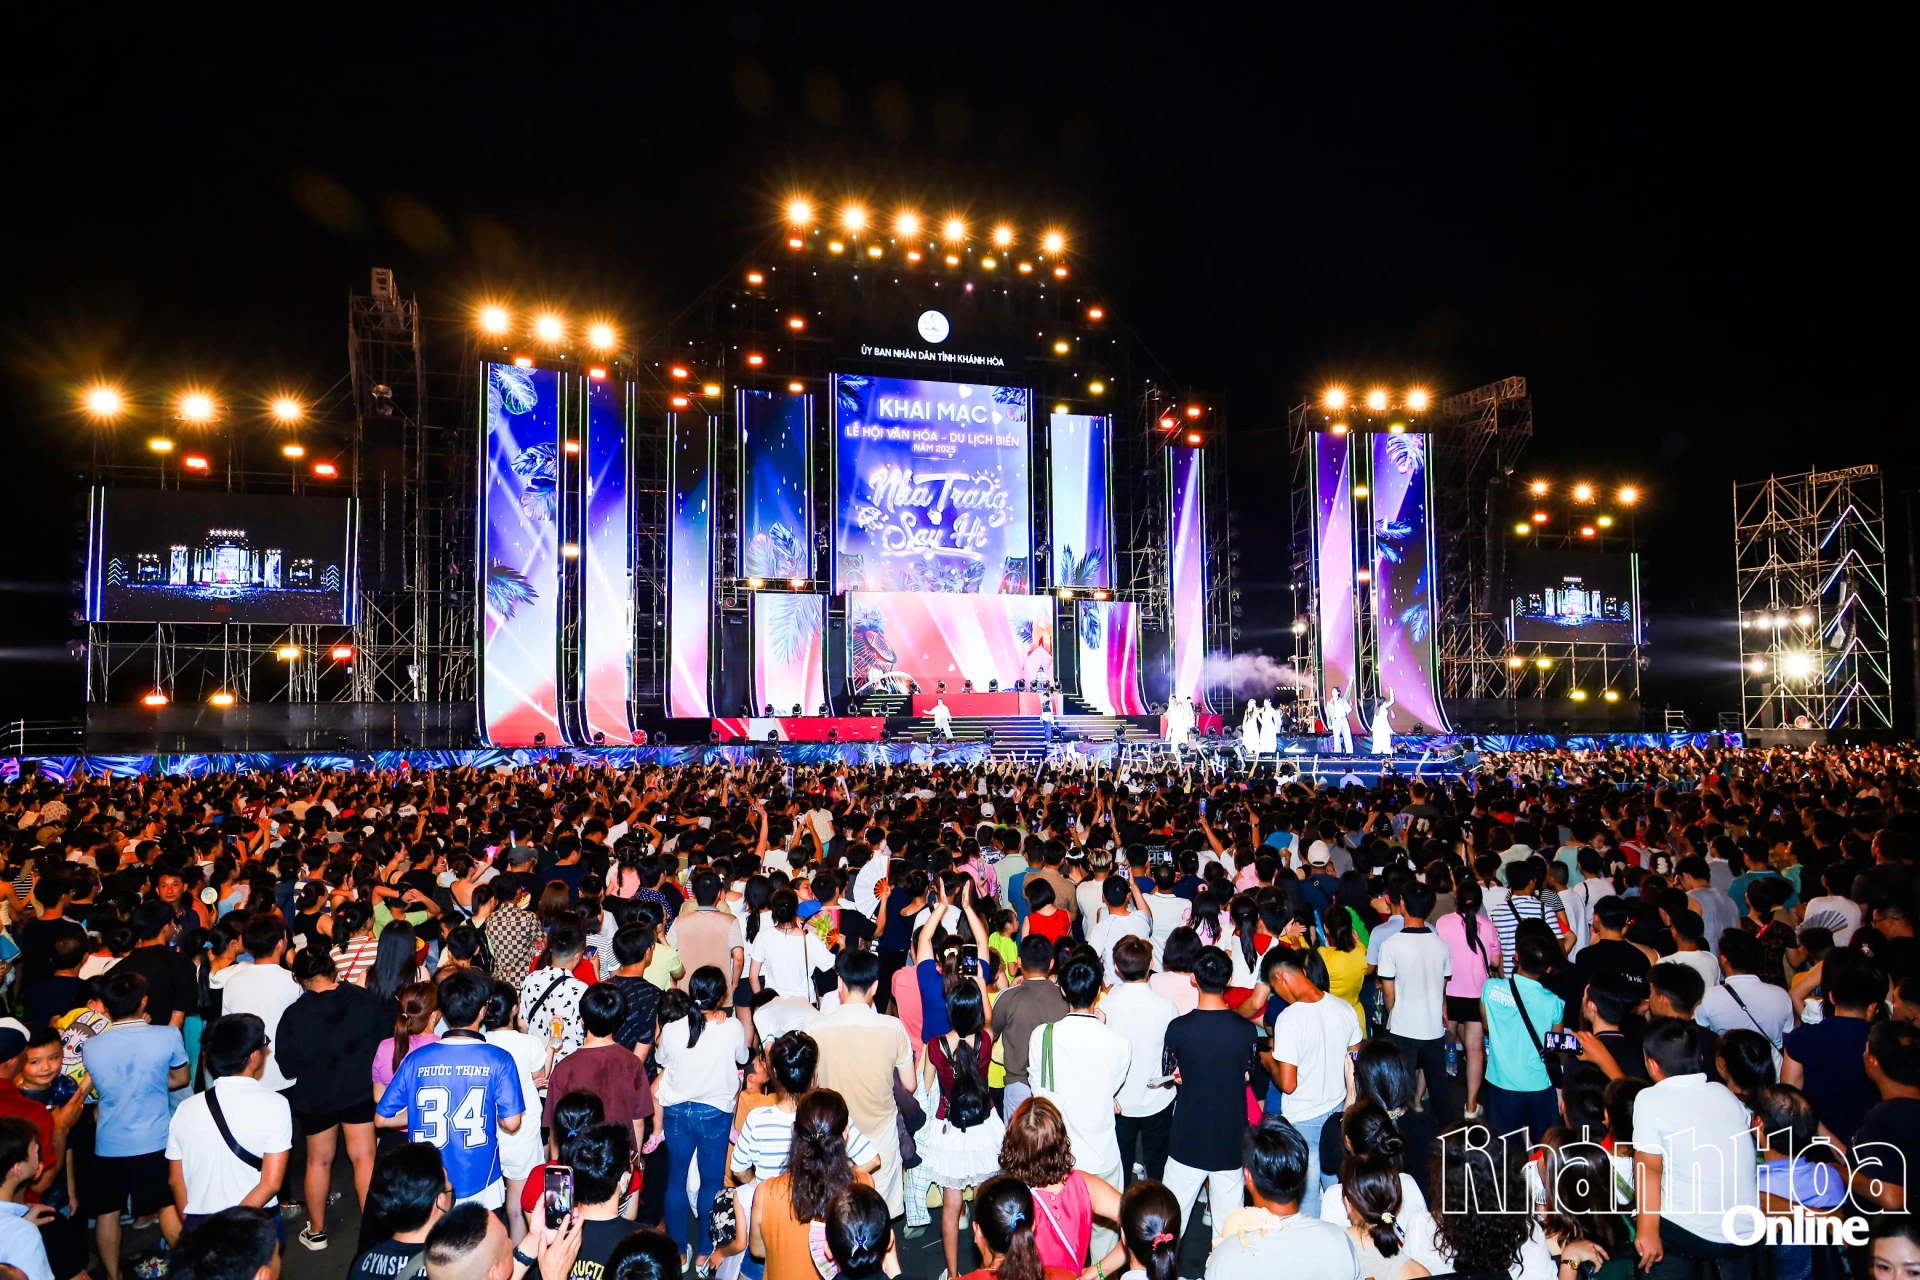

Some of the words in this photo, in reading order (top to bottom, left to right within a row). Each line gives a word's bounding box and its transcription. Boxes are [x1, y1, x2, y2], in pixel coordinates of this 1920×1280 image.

[861, 344, 873, 355] ỦY
[874, 347, 891, 357] BAN
[893, 348, 917, 359] NHÂN
[918, 350, 936, 361] DÂN
[937, 351, 956, 363] TỈNH
[957, 353, 985, 365] KHÁNH
[987, 355, 1004, 367] HÒA
[879, 399, 930, 420] KHAI
[937, 402, 988, 428] MẠC
[846, 421, 860, 437] LỄ
[862, 425, 883, 441] HỘI
[886, 427, 910, 440] VĂN
[913, 428, 938, 442] HÓA
[949, 433, 966, 444] DU
[967, 434, 993, 447] LỊCH
[995, 433, 1020, 448] BIỂN
[913, 442, 934, 452] NĂM
[935, 444, 956, 454] 2025
[869, 468, 933, 513] Nha
[913, 473, 1009, 528] Trang
[881, 512, 944, 559] Say
[950, 512, 988, 552] Hi
[417, 1064, 452, 1077] PHƯỚC
[455, 1065, 491, 1078] THỊNH
[413, 1085, 489, 1150] 34
